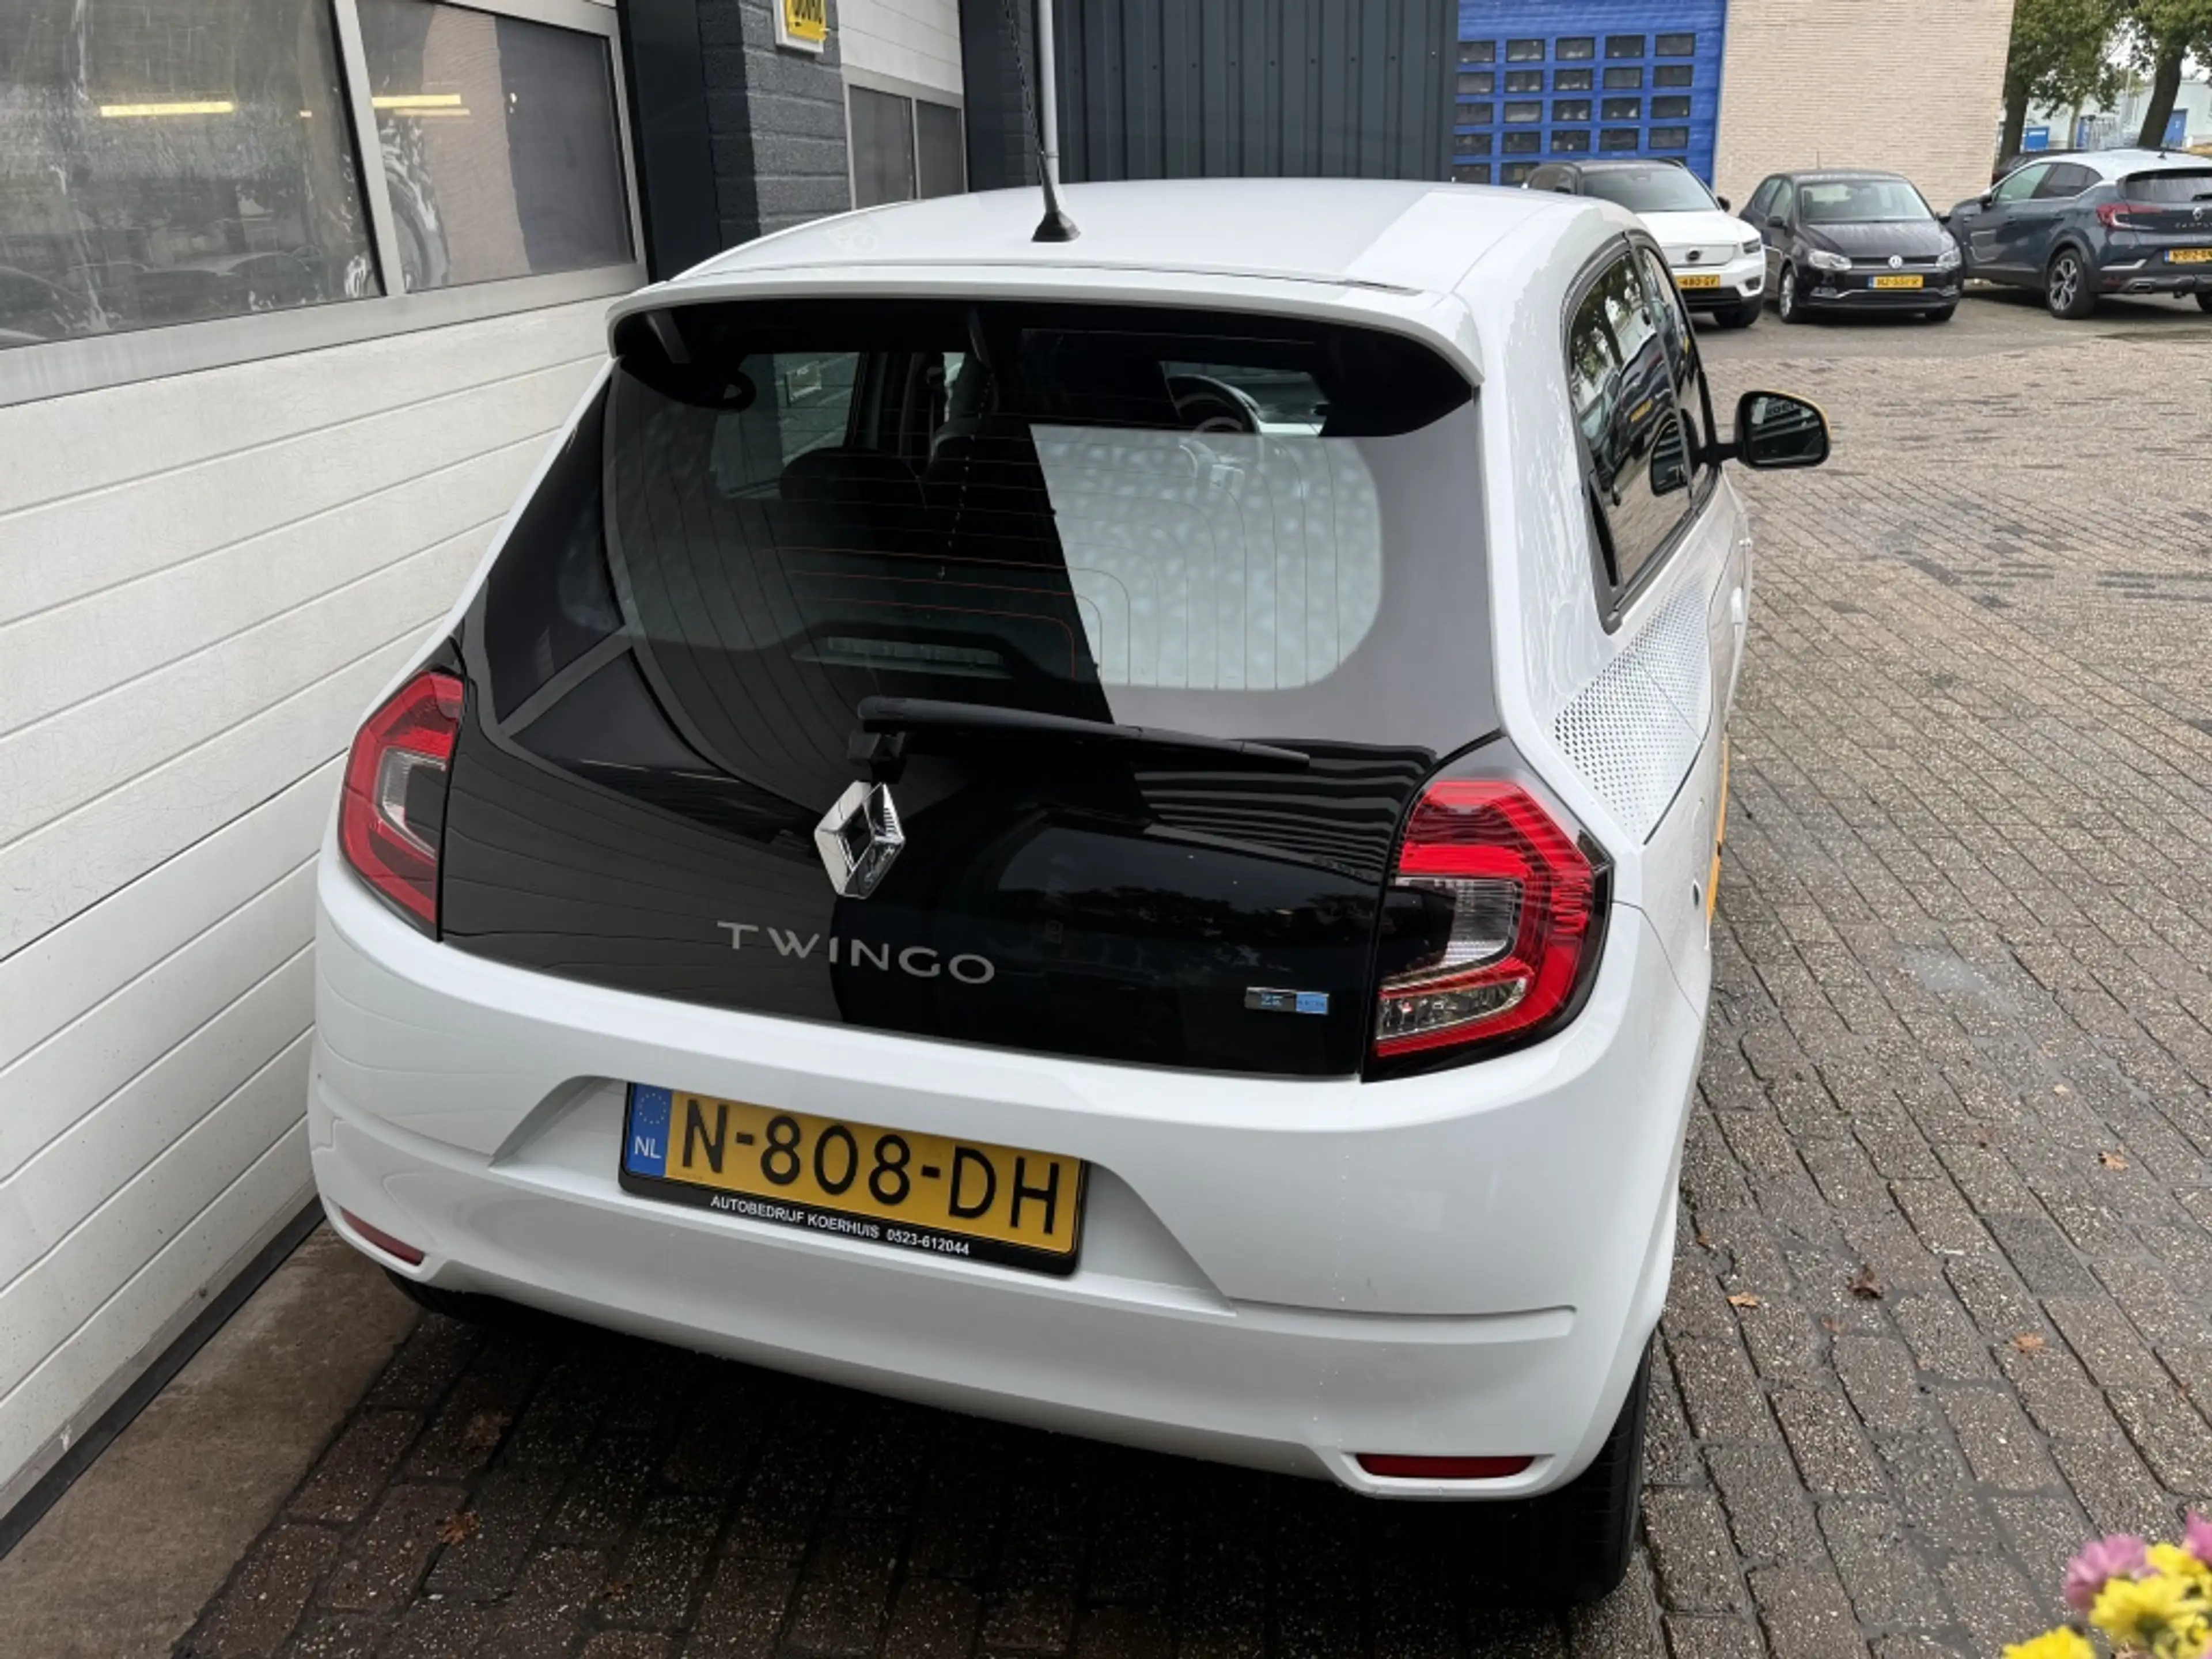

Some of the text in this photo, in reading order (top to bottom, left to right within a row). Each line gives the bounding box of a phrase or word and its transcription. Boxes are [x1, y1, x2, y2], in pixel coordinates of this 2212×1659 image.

[717, 921, 995, 984] TWINGO
[634, 1099, 1060, 1234] NL N-808-DH
[710, 1194, 970, 1256] AUTOBEDRIJF KOERHUIS 0523-612044
